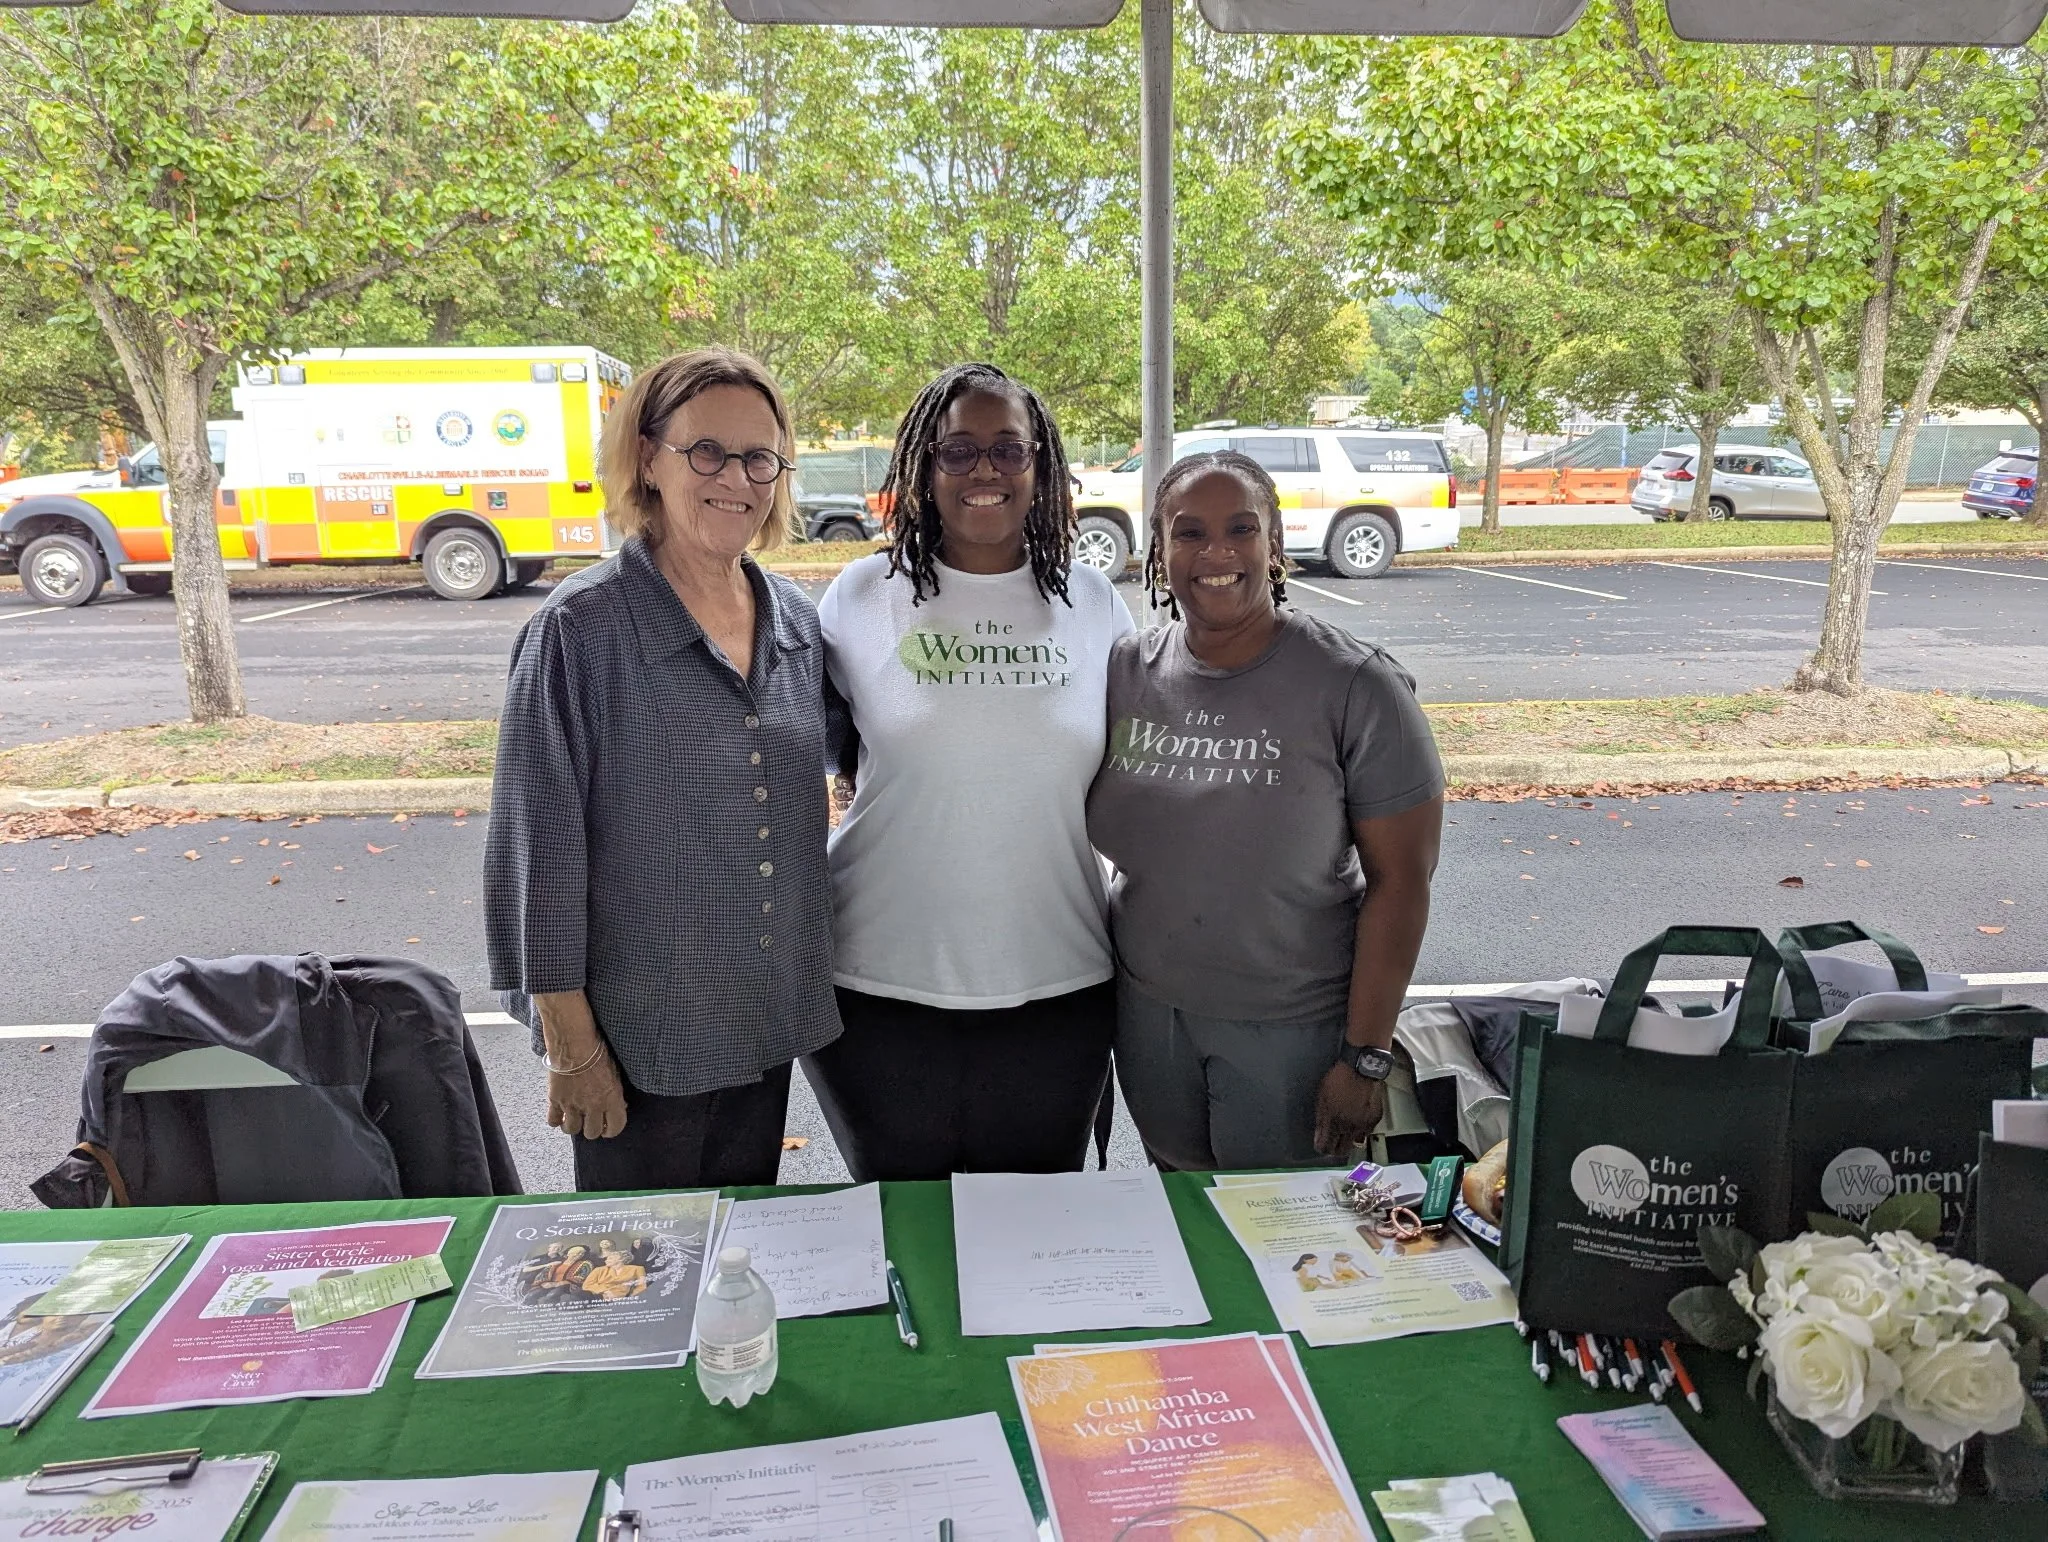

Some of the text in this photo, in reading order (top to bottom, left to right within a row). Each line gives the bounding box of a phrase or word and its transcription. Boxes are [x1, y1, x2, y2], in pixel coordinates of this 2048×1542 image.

[1386, 450, 1410, 461] 132
[519, 468, 549, 477] SQUAD
[324, 485, 393, 501] RESCUE
[558, 526, 595, 544] 145
[975, 620, 1013, 634] the
[916, 634, 1068, 664] Women's
[916, 670, 1071, 687] INITIATIVE
[1185, 710, 1224, 726] the
[1128, 718, 1281, 760] Women's
[1108, 755, 1280, 785] INITIATIVE
[1891, 1146, 1931, 1164] the
[1650, 1155, 1692, 1176] the
[1589, 1160, 1739, 1206] Women's
[1836, 1162, 1970, 1195] Women'
[1246, 1194, 1318, 1209] Resilience
[1587, 1200, 1736, 1230] INITIATIVE
[516, 1219, 679, 1241] Q Social Hour
[264, 1245, 375, 1262] Sister Circle
[219, 1254, 413, 1275] Yoga and Meditation
[223, 1379, 260, 1388] Circle
[230, 1372, 264, 1380] Sister
[1085, 1388, 1230, 1417] Chihamba
[1073, 1407, 1256, 1438] West African
[1126, 1431, 1220, 1456] Dance
[1193, 1450, 1225, 1458] CENTER
[642, 1463, 816, 1491] The Women's Initiative
[155, 1498, 192, 1509] 2025
[374, 1499, 500, 1520] Self-Care List
[19, 1510, 157, 1542] change
[362, 1520, 383, 1529] and
[466, 1517, 492, 1525] Care
